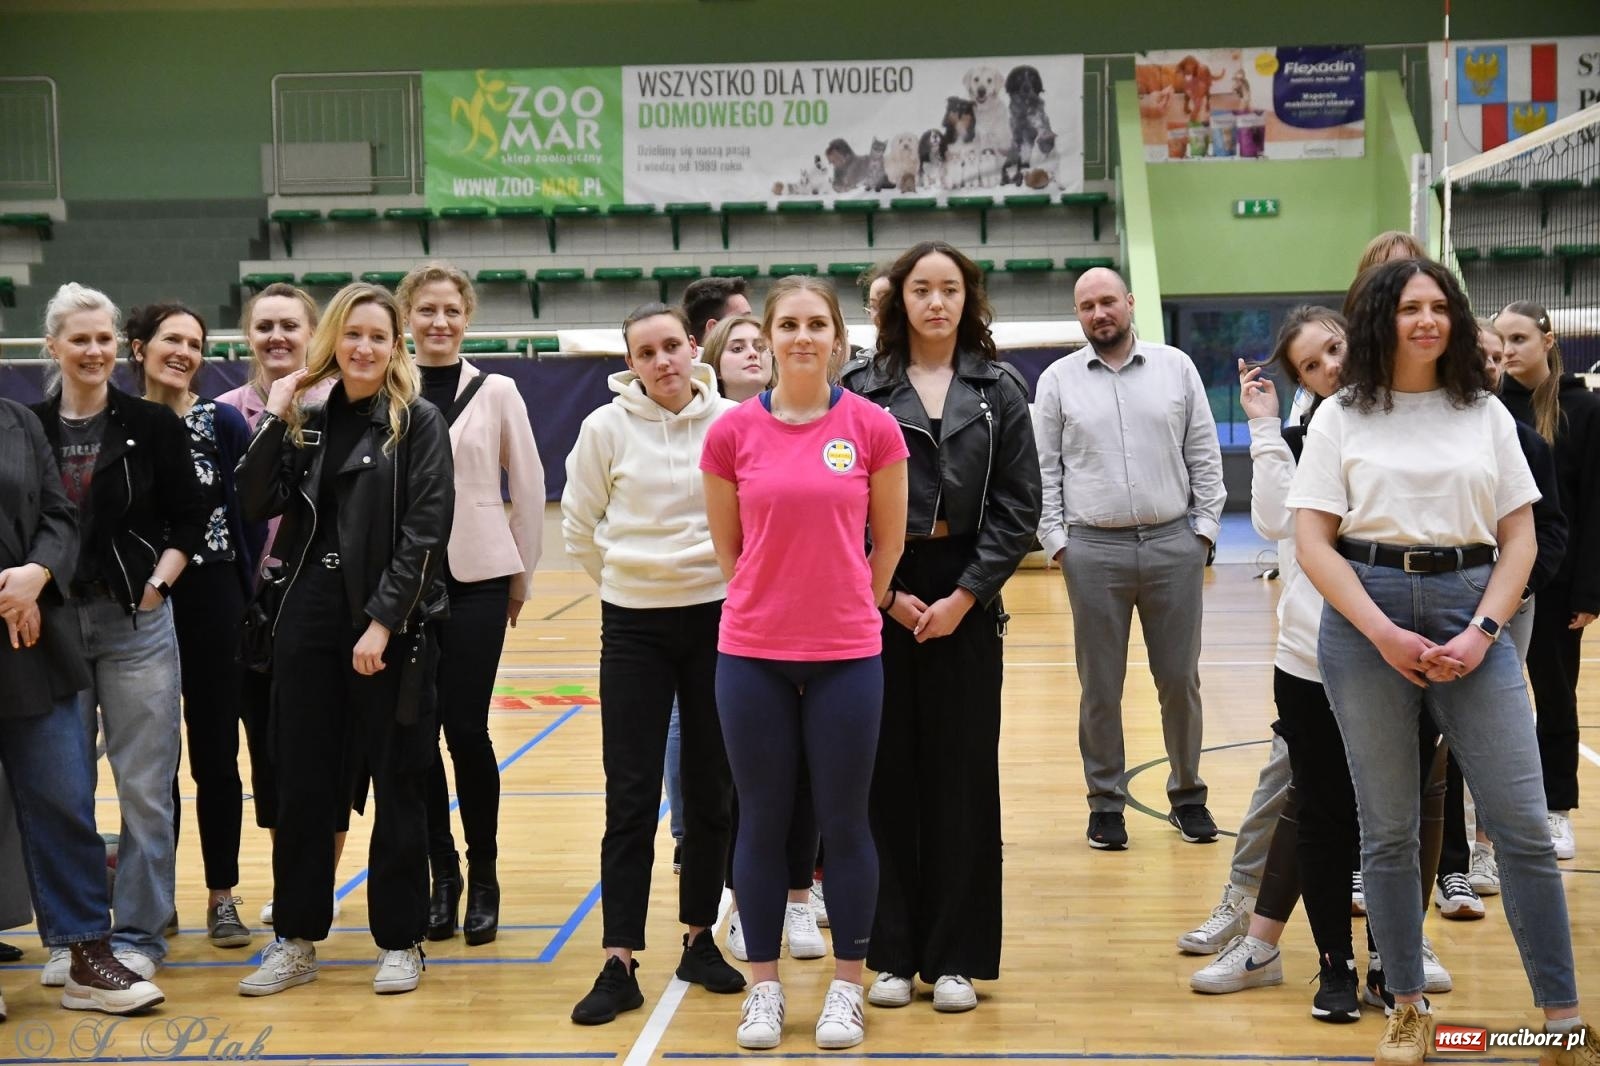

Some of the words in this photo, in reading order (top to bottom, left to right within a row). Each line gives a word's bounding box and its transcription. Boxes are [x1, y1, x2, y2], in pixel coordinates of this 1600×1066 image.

[1284, 60, 1356, 75] Flexadin
[1577, 51, 1600, 77] S
[637, 68, 755, 97] WSZYSTKO
[763, 67, 804, 95] DLA
[812, 66, 913, 94] TWOJEGO
[506, 85, 604, 118] ZOO
[638, 100, 774, 129] DOMOWEGO
[783, 99, 829, 126] ZOO
[500, 119, 602, 151] MAR
[501, 152, 531, 165] sklep
[535, 152, 603, 165] zoologiczny
[453, 176, 603, 197] WWW.ZOO-MAR.PL
